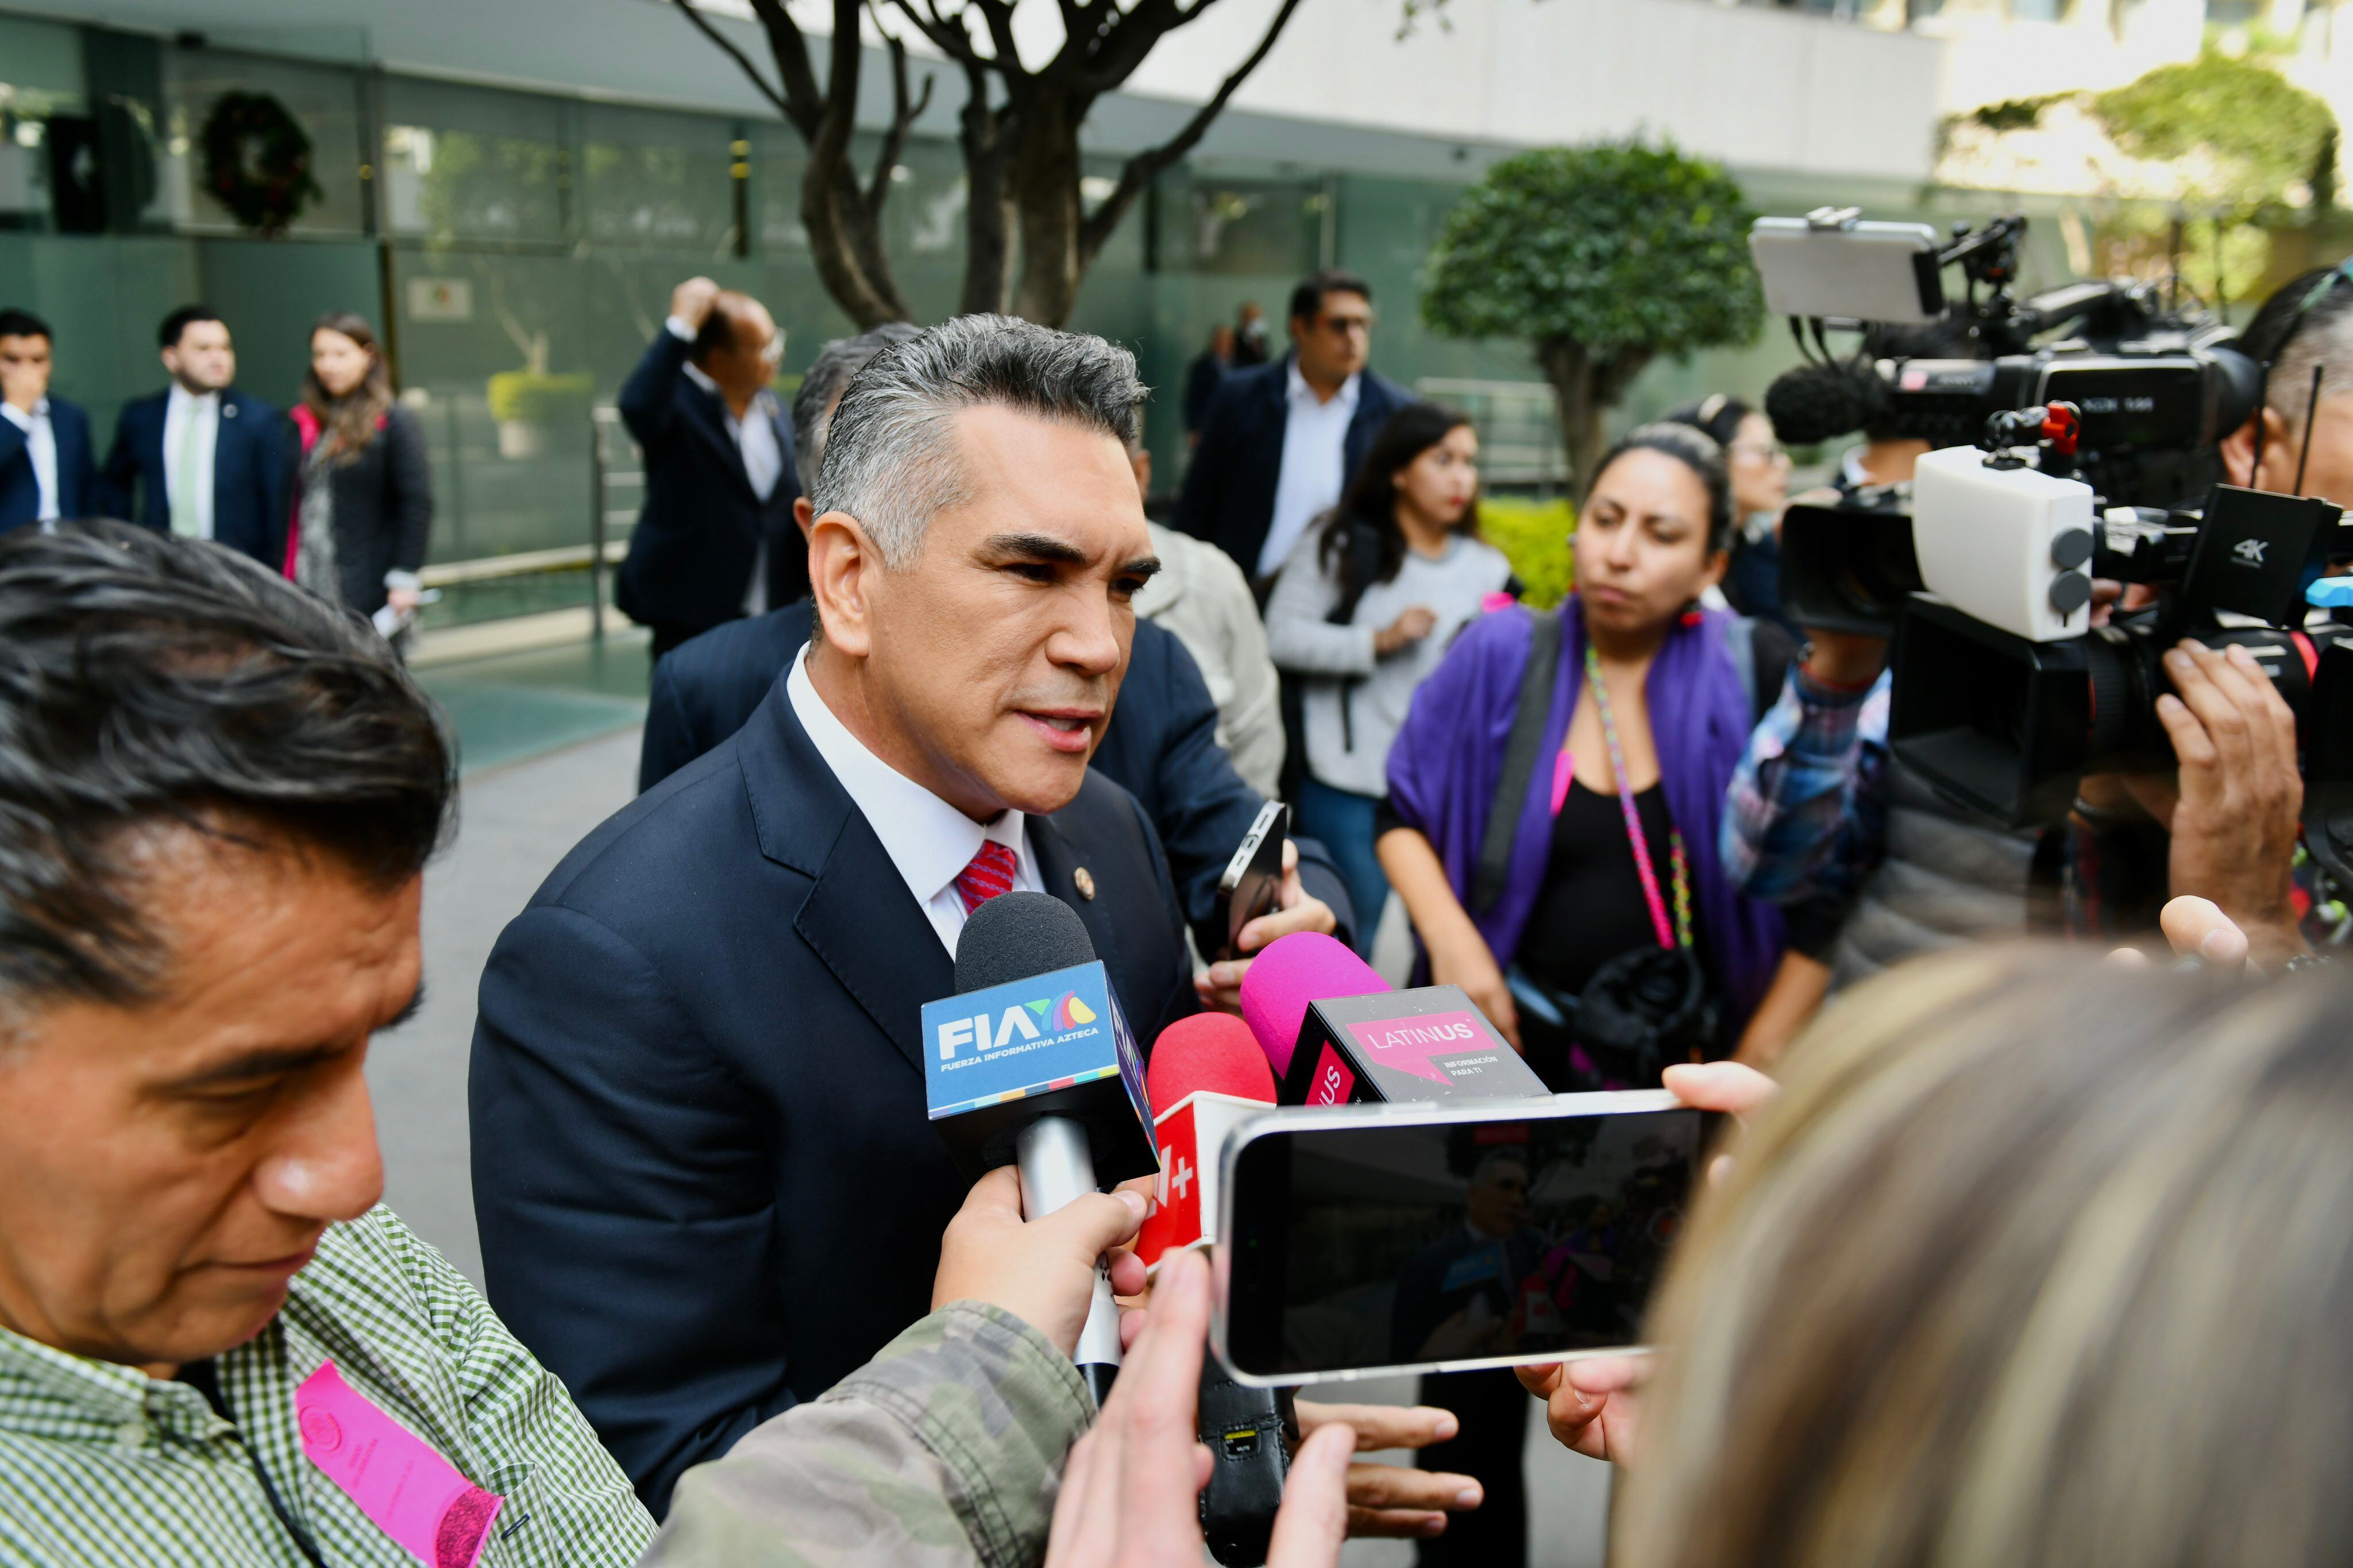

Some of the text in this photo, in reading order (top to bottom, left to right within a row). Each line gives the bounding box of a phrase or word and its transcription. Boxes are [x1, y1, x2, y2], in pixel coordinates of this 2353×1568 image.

[2234, 539, 2269, 562] 4K
[938, 1005, 1040, 1060] FIA
[1367, 1023, 1473, 1049] LATINUS
[941, 1027, 1098, 1072] FUERZA INFORMATIVA AZTECA
[1444, 1056, 1498, 1068] INFORMACIÓN
[1451, 1068, 1475, 1076] PARA
